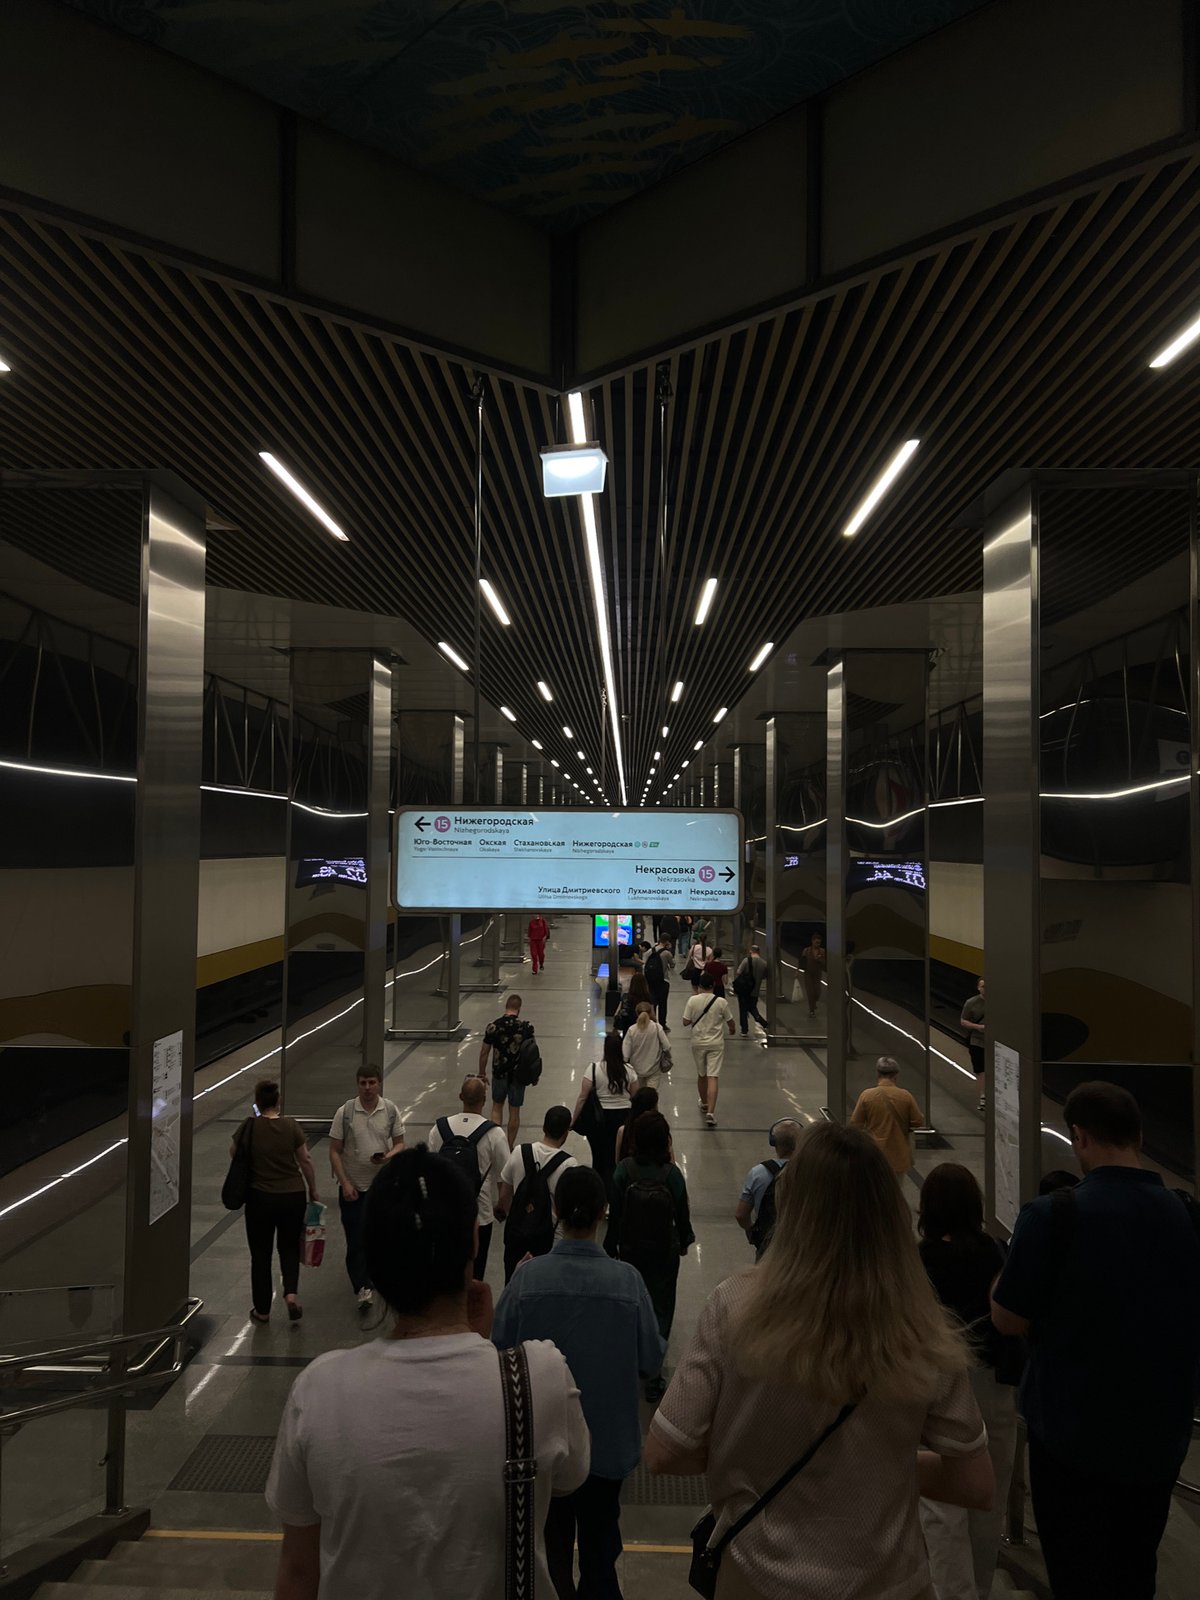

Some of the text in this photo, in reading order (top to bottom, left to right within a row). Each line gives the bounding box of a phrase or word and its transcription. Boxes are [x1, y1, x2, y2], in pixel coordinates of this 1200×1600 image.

[437, 816, 534, 829] 15 Нижегородская
[454, 827, 510, 835] Nizhegorodskaya
[414, 838, 472, 846] Юго-Восточная
[513, 839, 566, 847] Стахановская
[573, 840, 633, 849] Нижегородская
[635, 865, 713, 879] Некрасовка 15
[538, 886, 621, 894] Улица Дмитриевского
[627, 887, 682, 895] Лухмановская
[690, 888, 735, 896] Некрасовка
